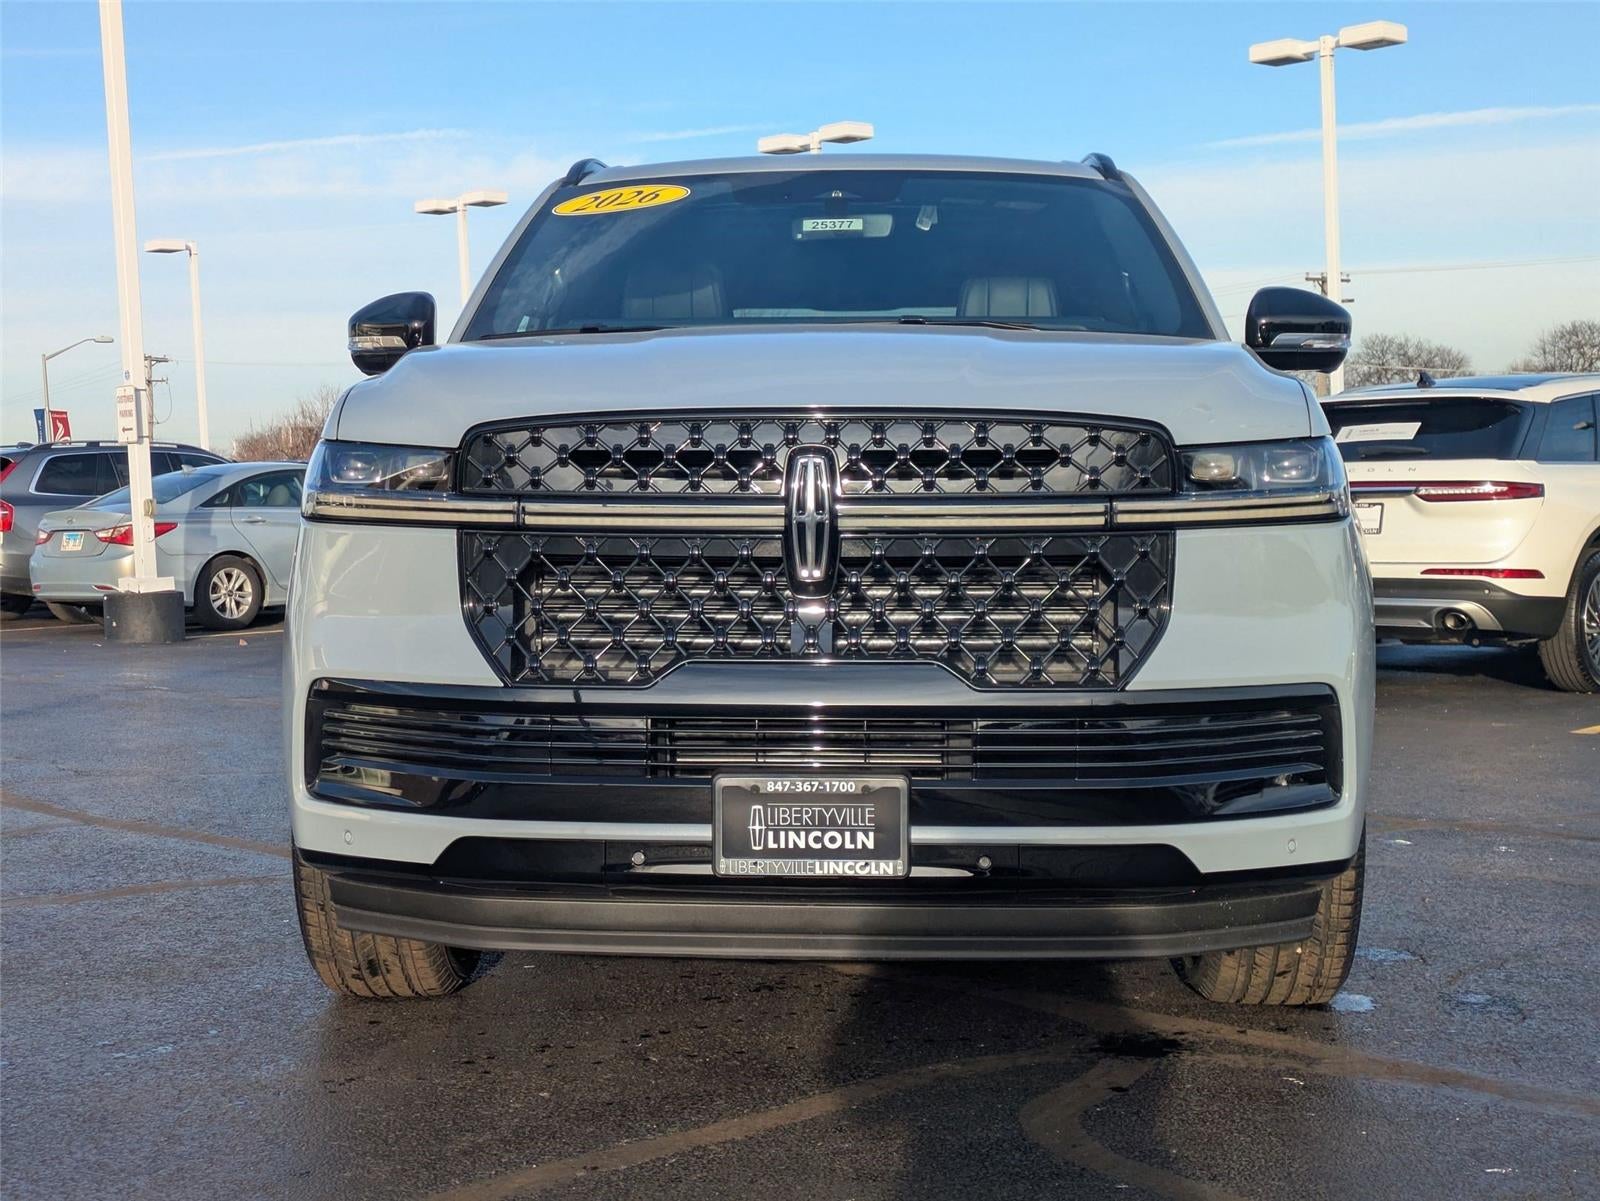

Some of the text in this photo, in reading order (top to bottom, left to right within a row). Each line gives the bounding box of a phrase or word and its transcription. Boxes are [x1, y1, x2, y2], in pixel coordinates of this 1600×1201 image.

[569, 188, 669, 213] 2026
[811, 220, 855, 231] 25377
[766, 781, 856, 793] 847-367-1700
[767, 807, 876, 826] LIBERTYVILLE
[767, 831, 876, 850] LINCOLN
